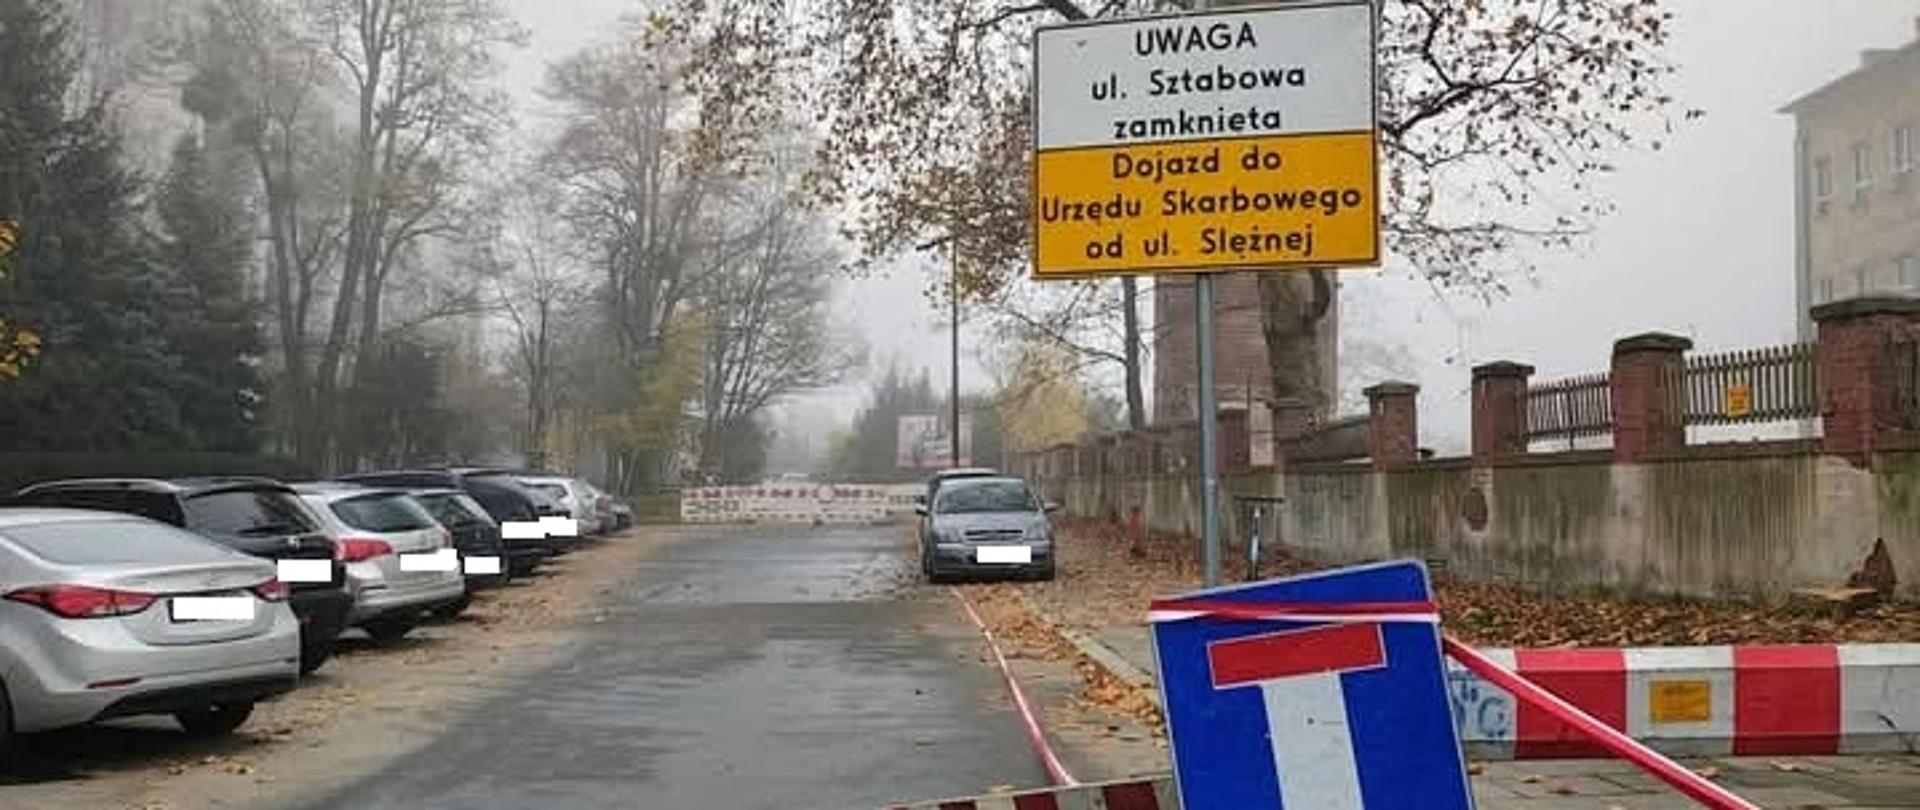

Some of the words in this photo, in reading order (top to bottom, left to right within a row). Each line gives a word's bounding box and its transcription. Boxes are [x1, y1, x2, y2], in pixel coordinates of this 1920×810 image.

[1135, 22, 1257, 56] UWAGA
[1091, 74, 1127, 101] ul.
[1149, 66, 1306, 97] Sztabowa
[1113, 107, 1282, 139] zamknieta
[1112, 148, 1220, 183] Dojazd
[1241, 145, 1283, 171] do
[1042, 194, 1142, 225] Urzędu
[1161, 187, 1363, 216] Skarbowego
[1086, 234, 1123, 259] od
[1144, 230, 1178, 257] ul.
